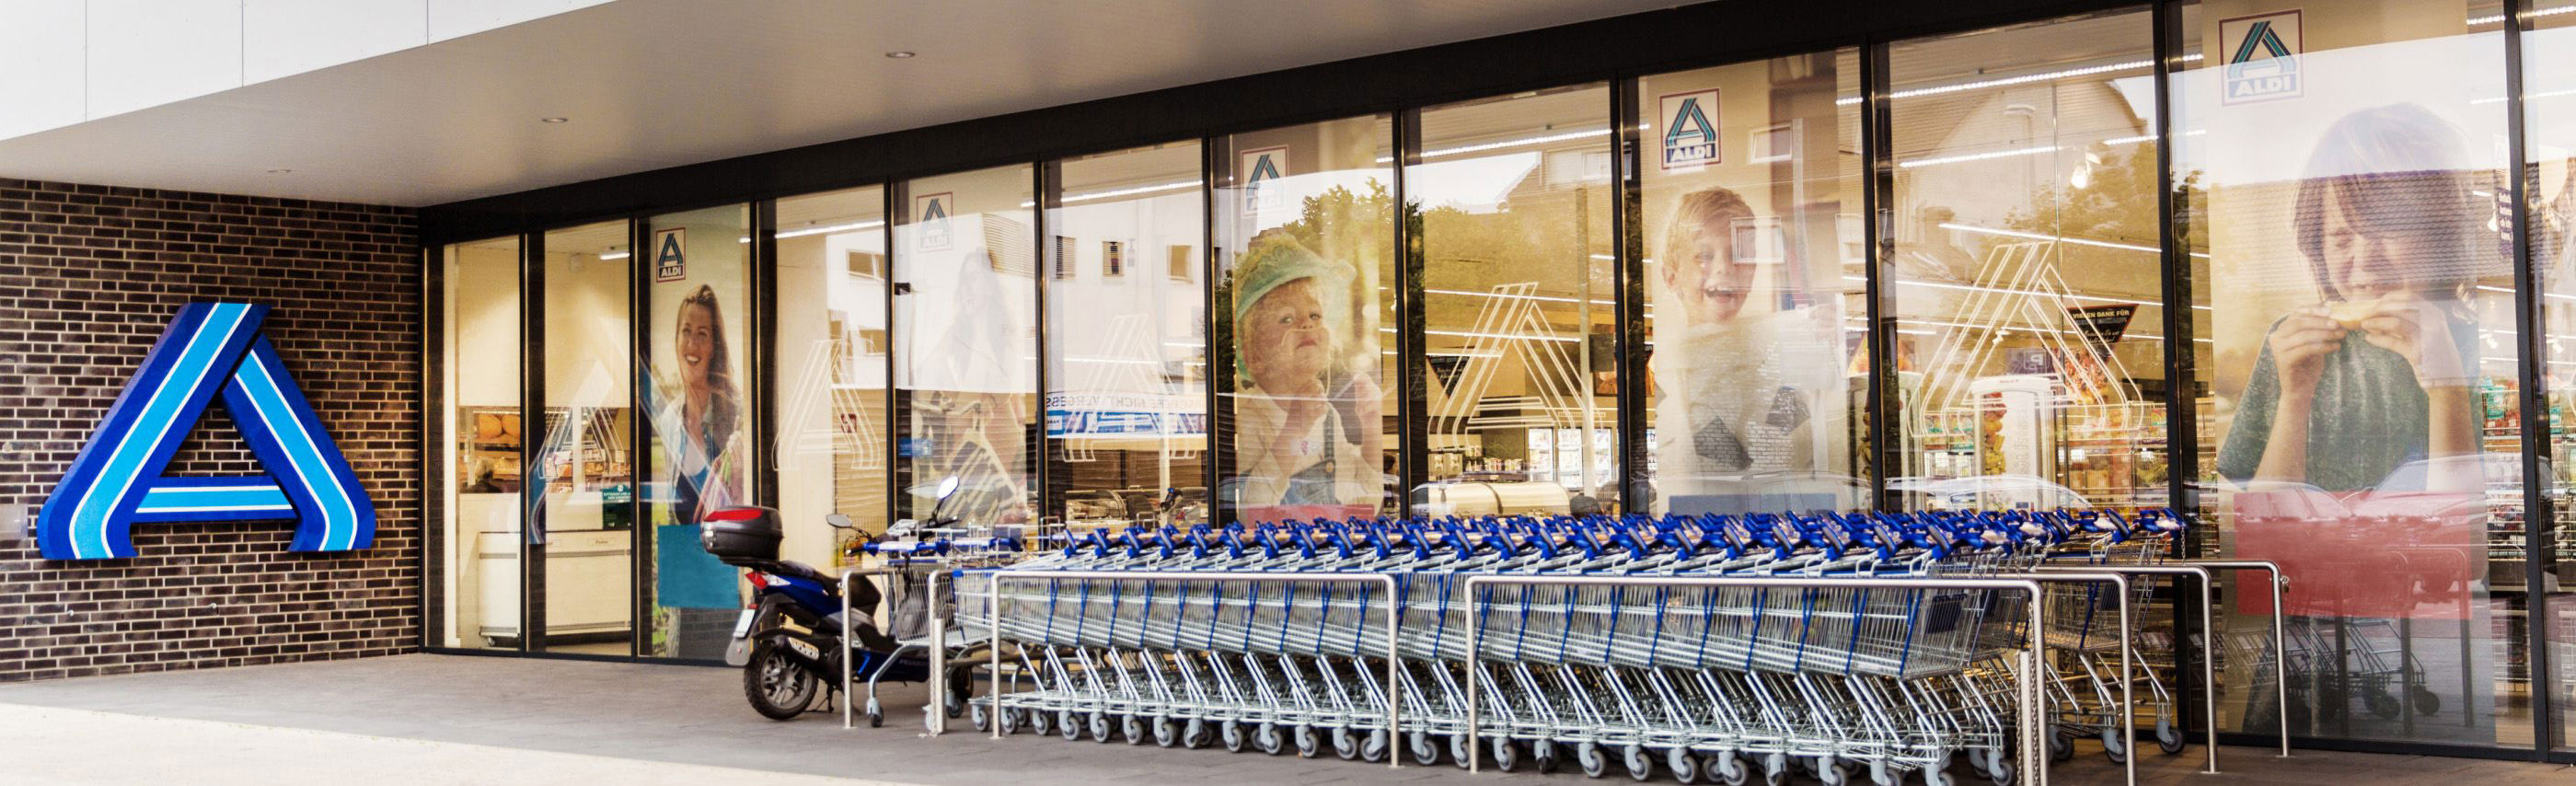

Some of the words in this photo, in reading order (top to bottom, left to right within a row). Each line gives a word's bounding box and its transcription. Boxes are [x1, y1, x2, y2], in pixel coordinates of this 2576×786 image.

[2235, 75, 2291, 97] ALDI
[1670, 144, 1712, 163] ALDI
[661, 266, 682, 278] ALDI
